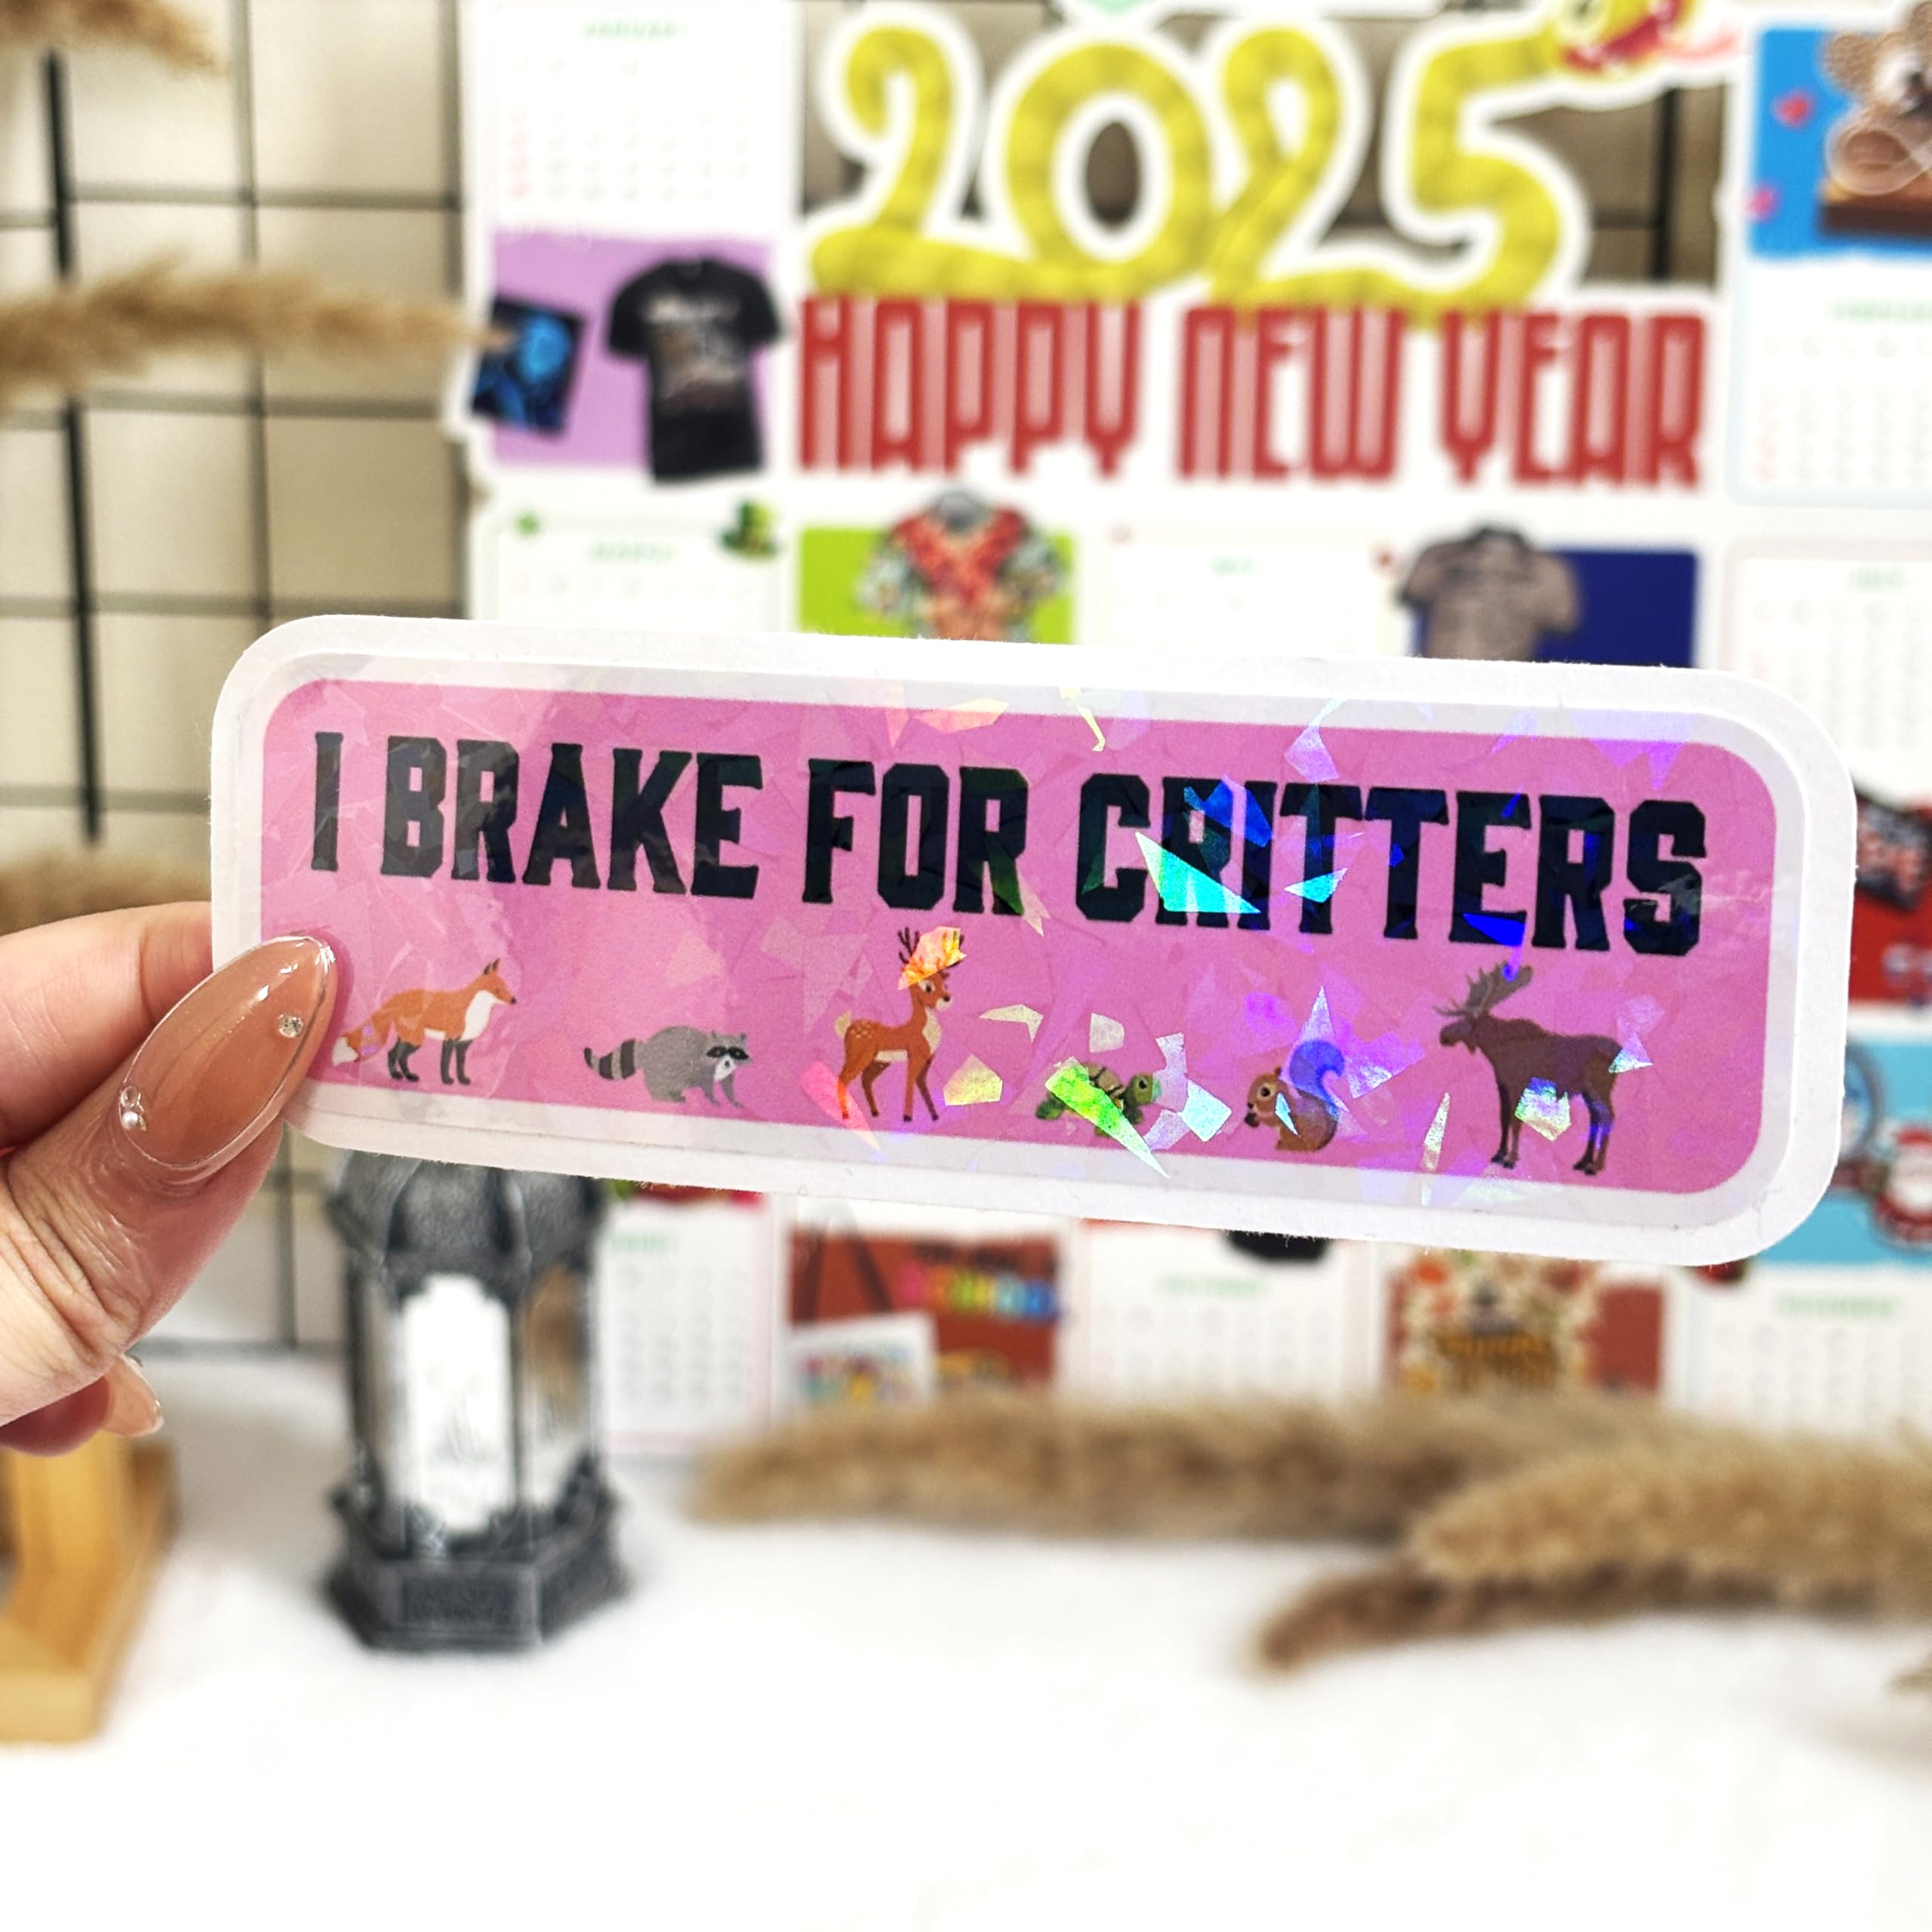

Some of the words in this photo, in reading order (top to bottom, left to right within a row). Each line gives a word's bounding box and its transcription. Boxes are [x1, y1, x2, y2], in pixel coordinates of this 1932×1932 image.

[813, 25, 1561, 321] 2025
[800, 293, 1142, 481] HAPPY
[1177, 305, 1402, 481] NEW
[1439, 306, 1706, 491] YEAR
[310, 731, 344, 872] I
[380, 735, 762, 899] BRAKE
[801, 758, 1029, 916] FOR
[1075, 773, 1707, 957] CRITTERS
